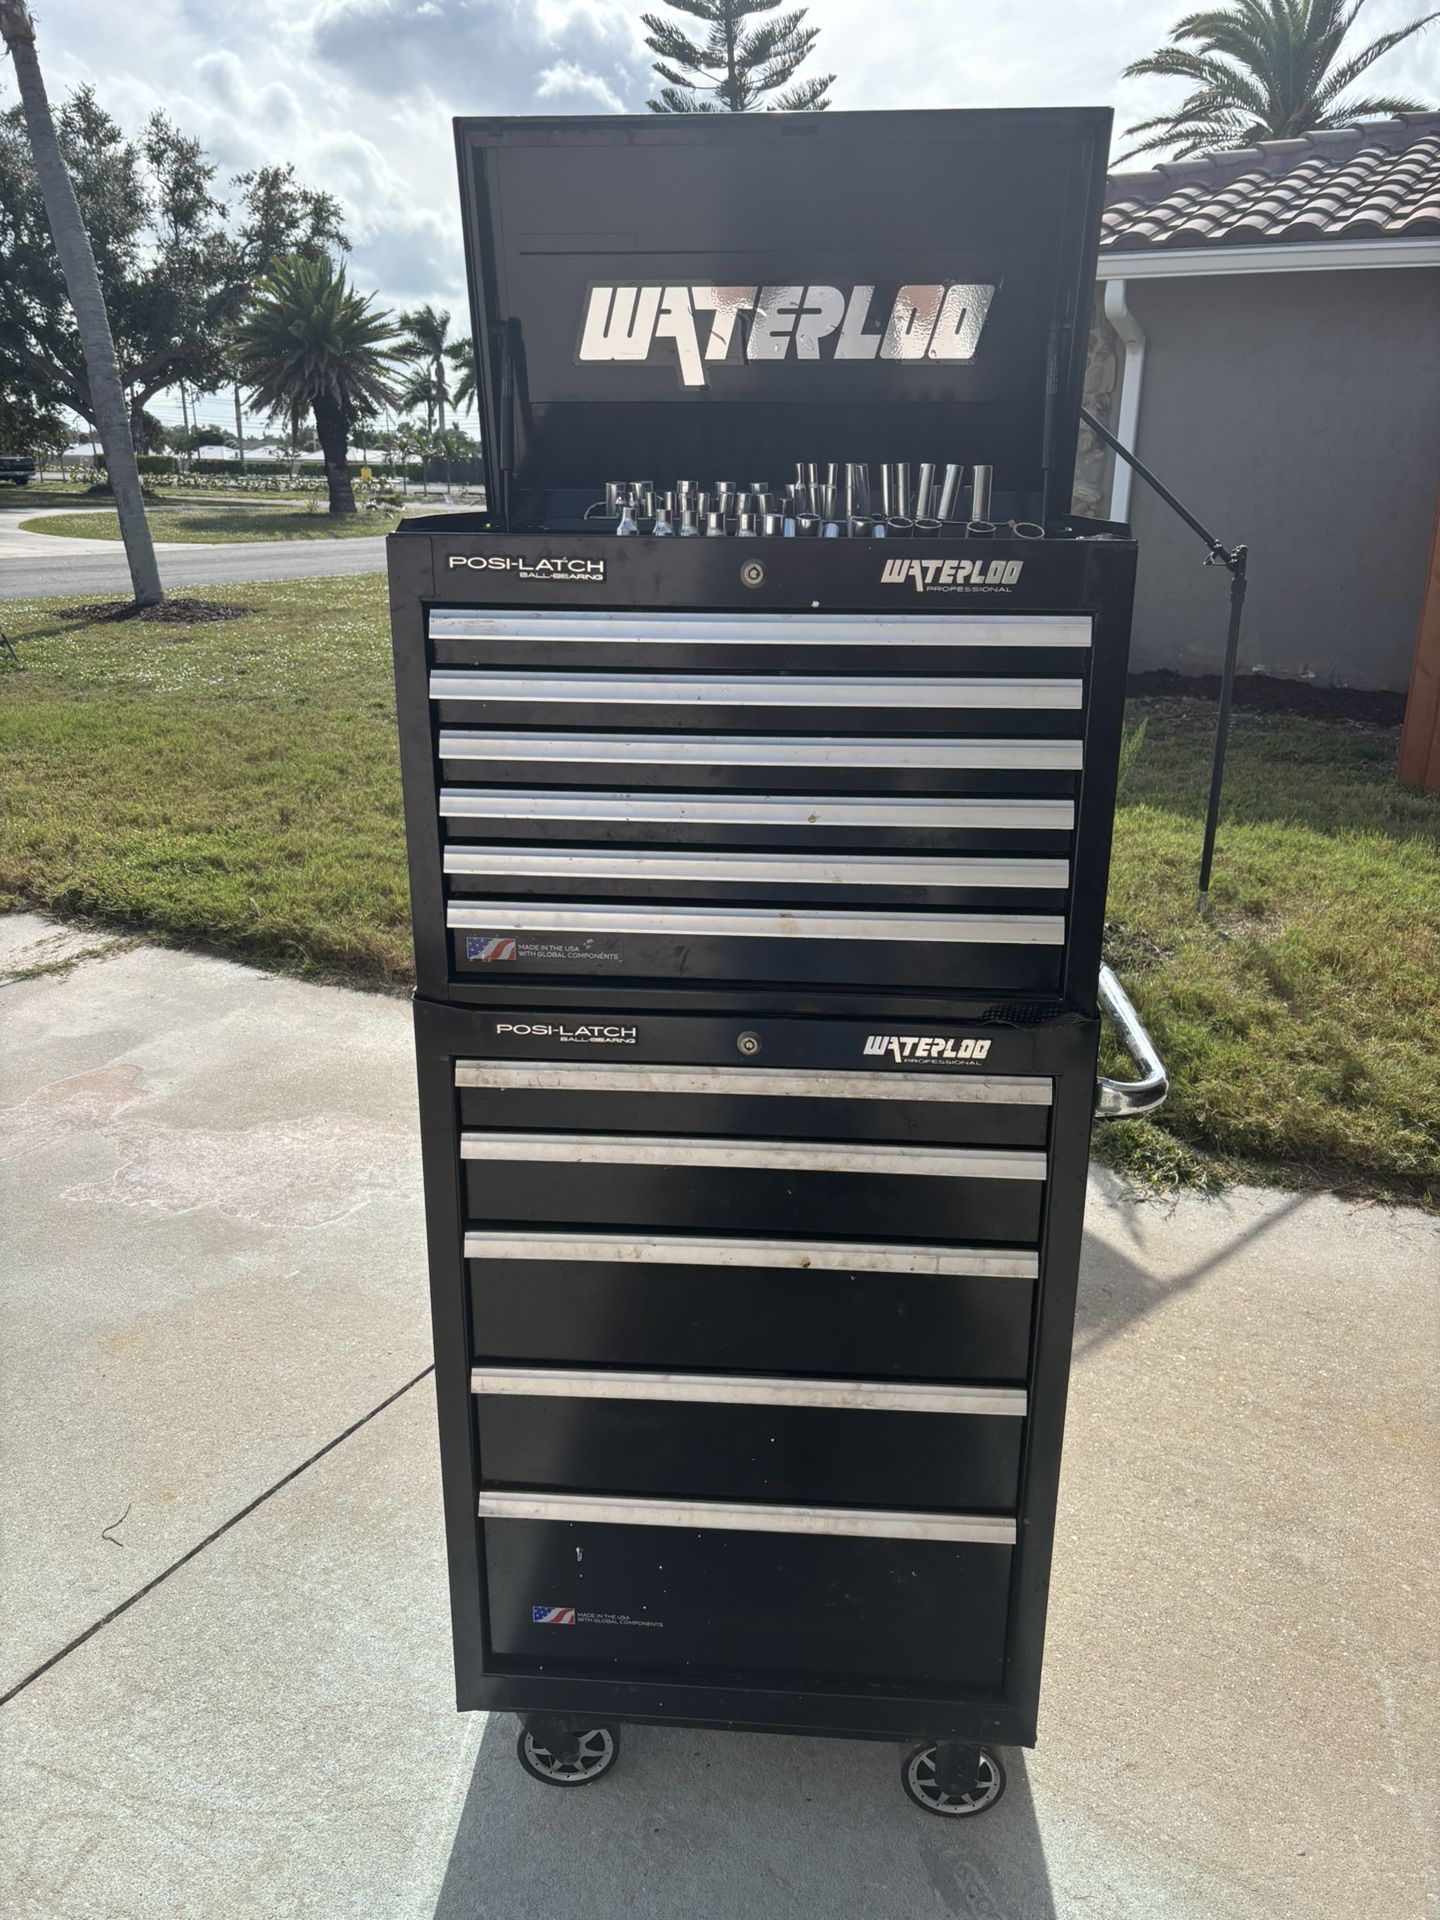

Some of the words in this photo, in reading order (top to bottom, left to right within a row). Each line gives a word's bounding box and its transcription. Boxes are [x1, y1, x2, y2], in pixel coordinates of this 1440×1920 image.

[580, 285, 996, 386] WATERLOO
[449, 556, 605, 573] POSI-LATCH
[519, 571, 604, 580] BALL-BEARING
[880, 559, 1024, 593] WATERLOO
[567, 952, 619, 960] COMPONENTS
[496, 1024, 637, 1037] POSI-LATCH
[560, 1036, 636, 1044] BALL-BEARING
[863, 1036, 992, 1063] WATERLOO
[904, 1058, 983, 1066] PROFESSIONAL
